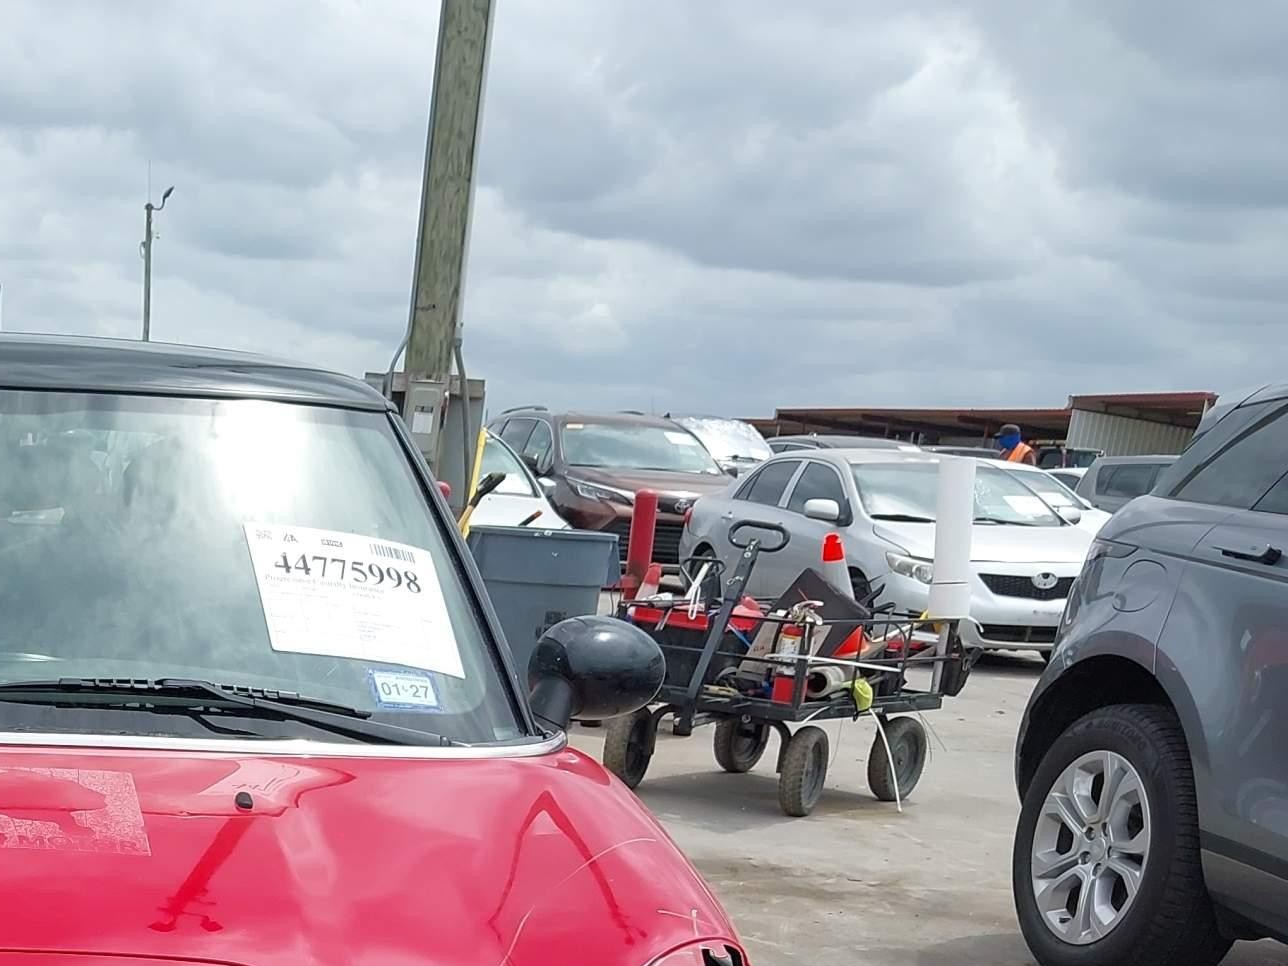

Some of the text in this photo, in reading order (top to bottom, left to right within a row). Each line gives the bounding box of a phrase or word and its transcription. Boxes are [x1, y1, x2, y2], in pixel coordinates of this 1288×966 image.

[274, 551, 422, 594] 44775998
[380, 681, 430, 699] 01 27
